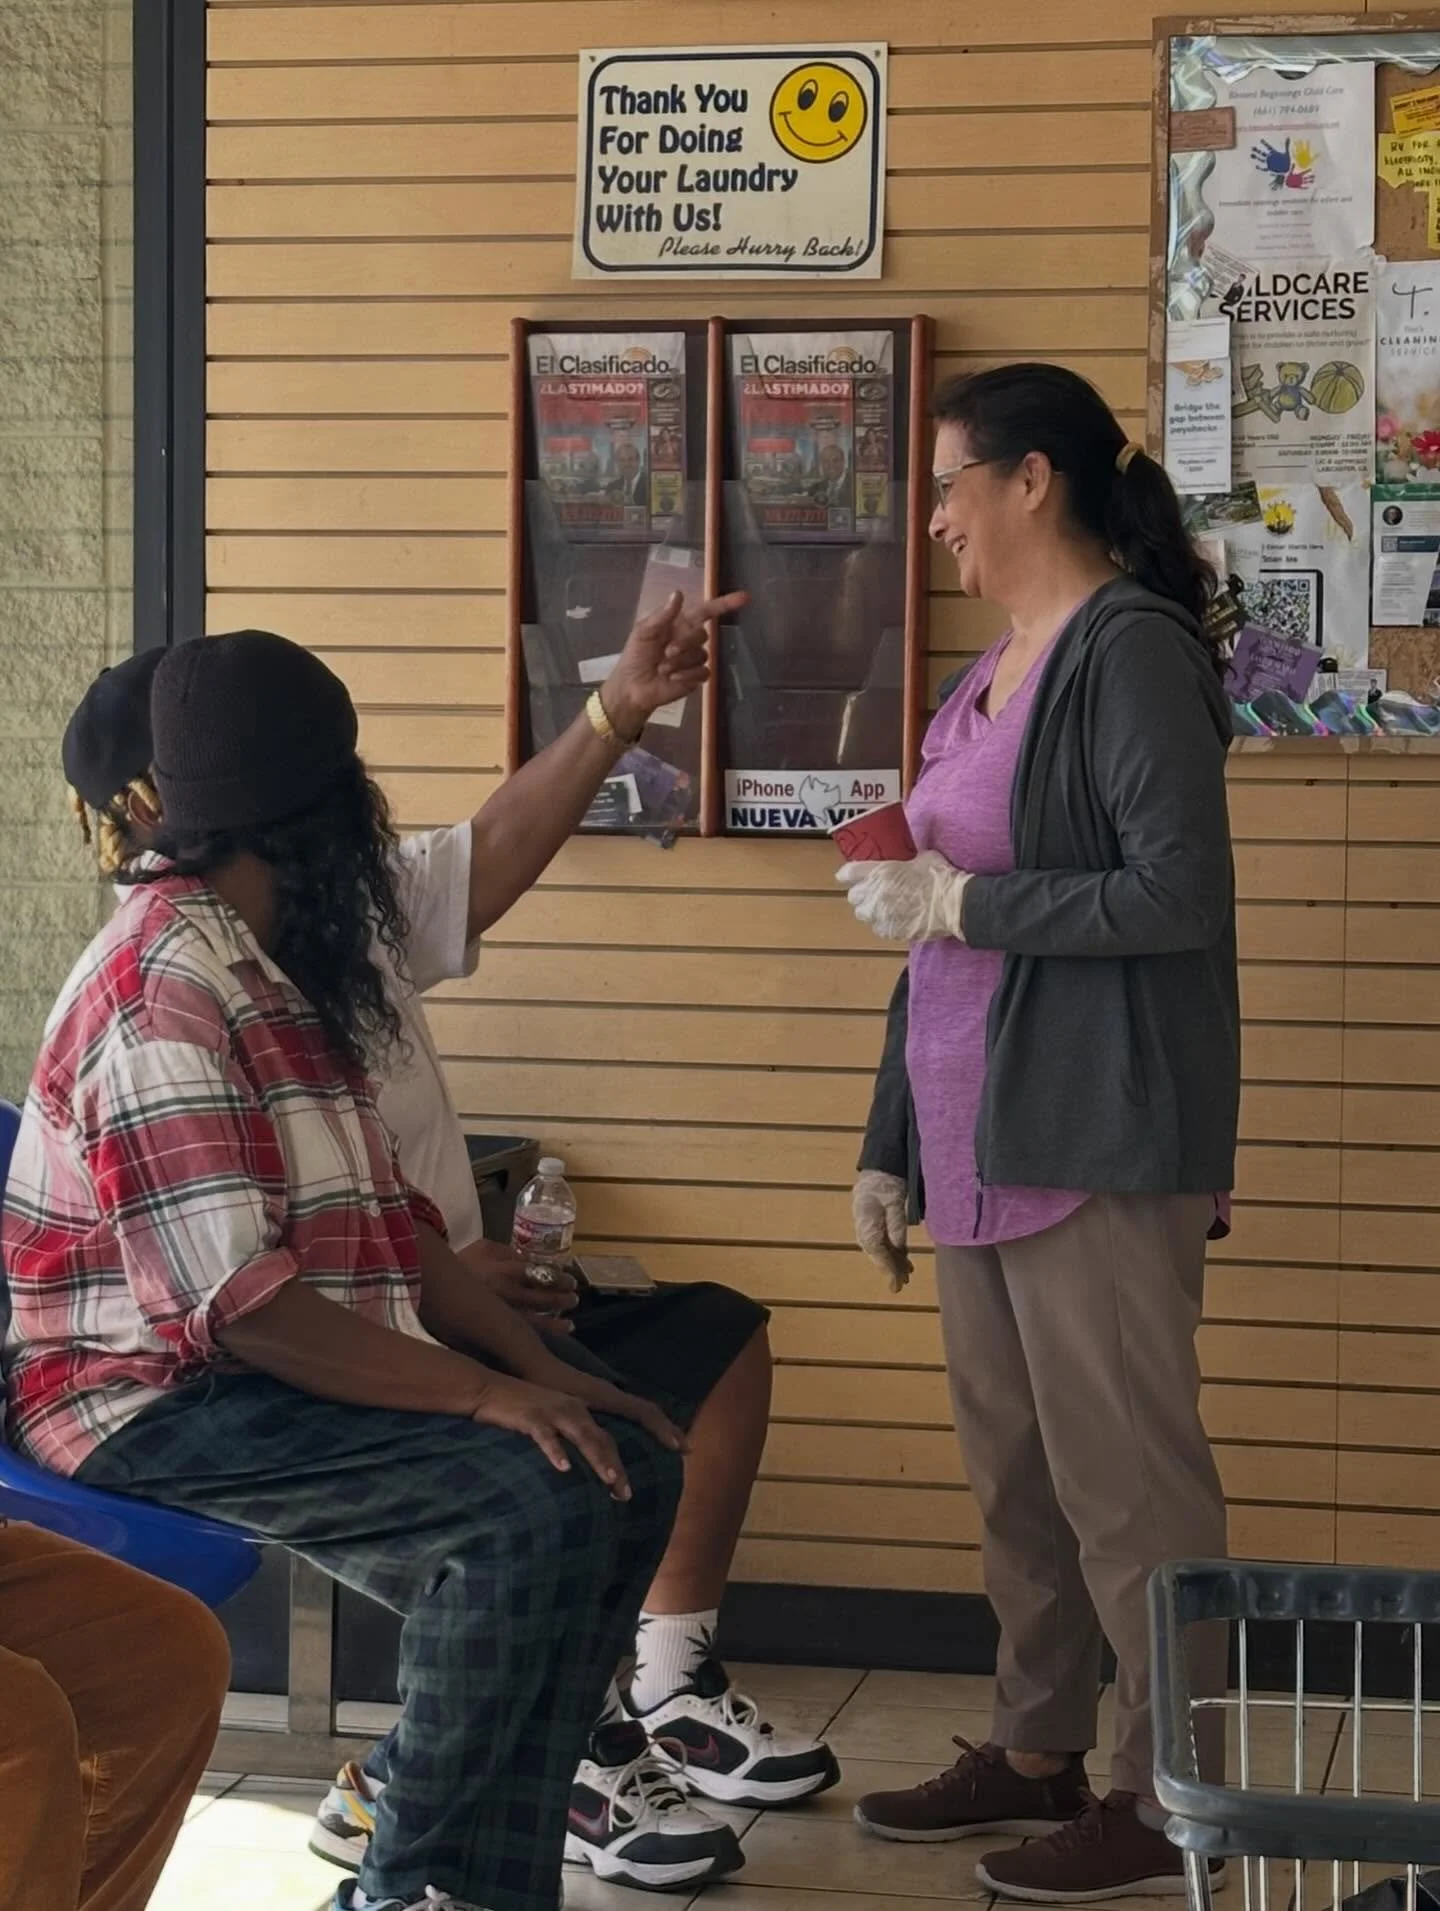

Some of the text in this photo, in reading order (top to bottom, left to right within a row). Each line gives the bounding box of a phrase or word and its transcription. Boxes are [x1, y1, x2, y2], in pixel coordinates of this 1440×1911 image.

[600, 84, 748, 115] Thank You
[599, 124, 744, 155] For Doing
[599, 162, 798, 194] Your Laundry
[596, 203, 723, 233] With Us!
[658, 236, 864, 263] Please Hurry Back!
[1218, 298, 1356, 323] SERVICES
[536, 354, 670, 374] El Clasificado
[740, 354, 877, 374] El Clasificado
[540, 382, 644, 395] ¿LASTIMADO?
[744, 382, 849, 396] ¿LASTIMADO?
[736, 778, 886, 800] iPhone App
[731, 807, 818, 828] NUEVA
